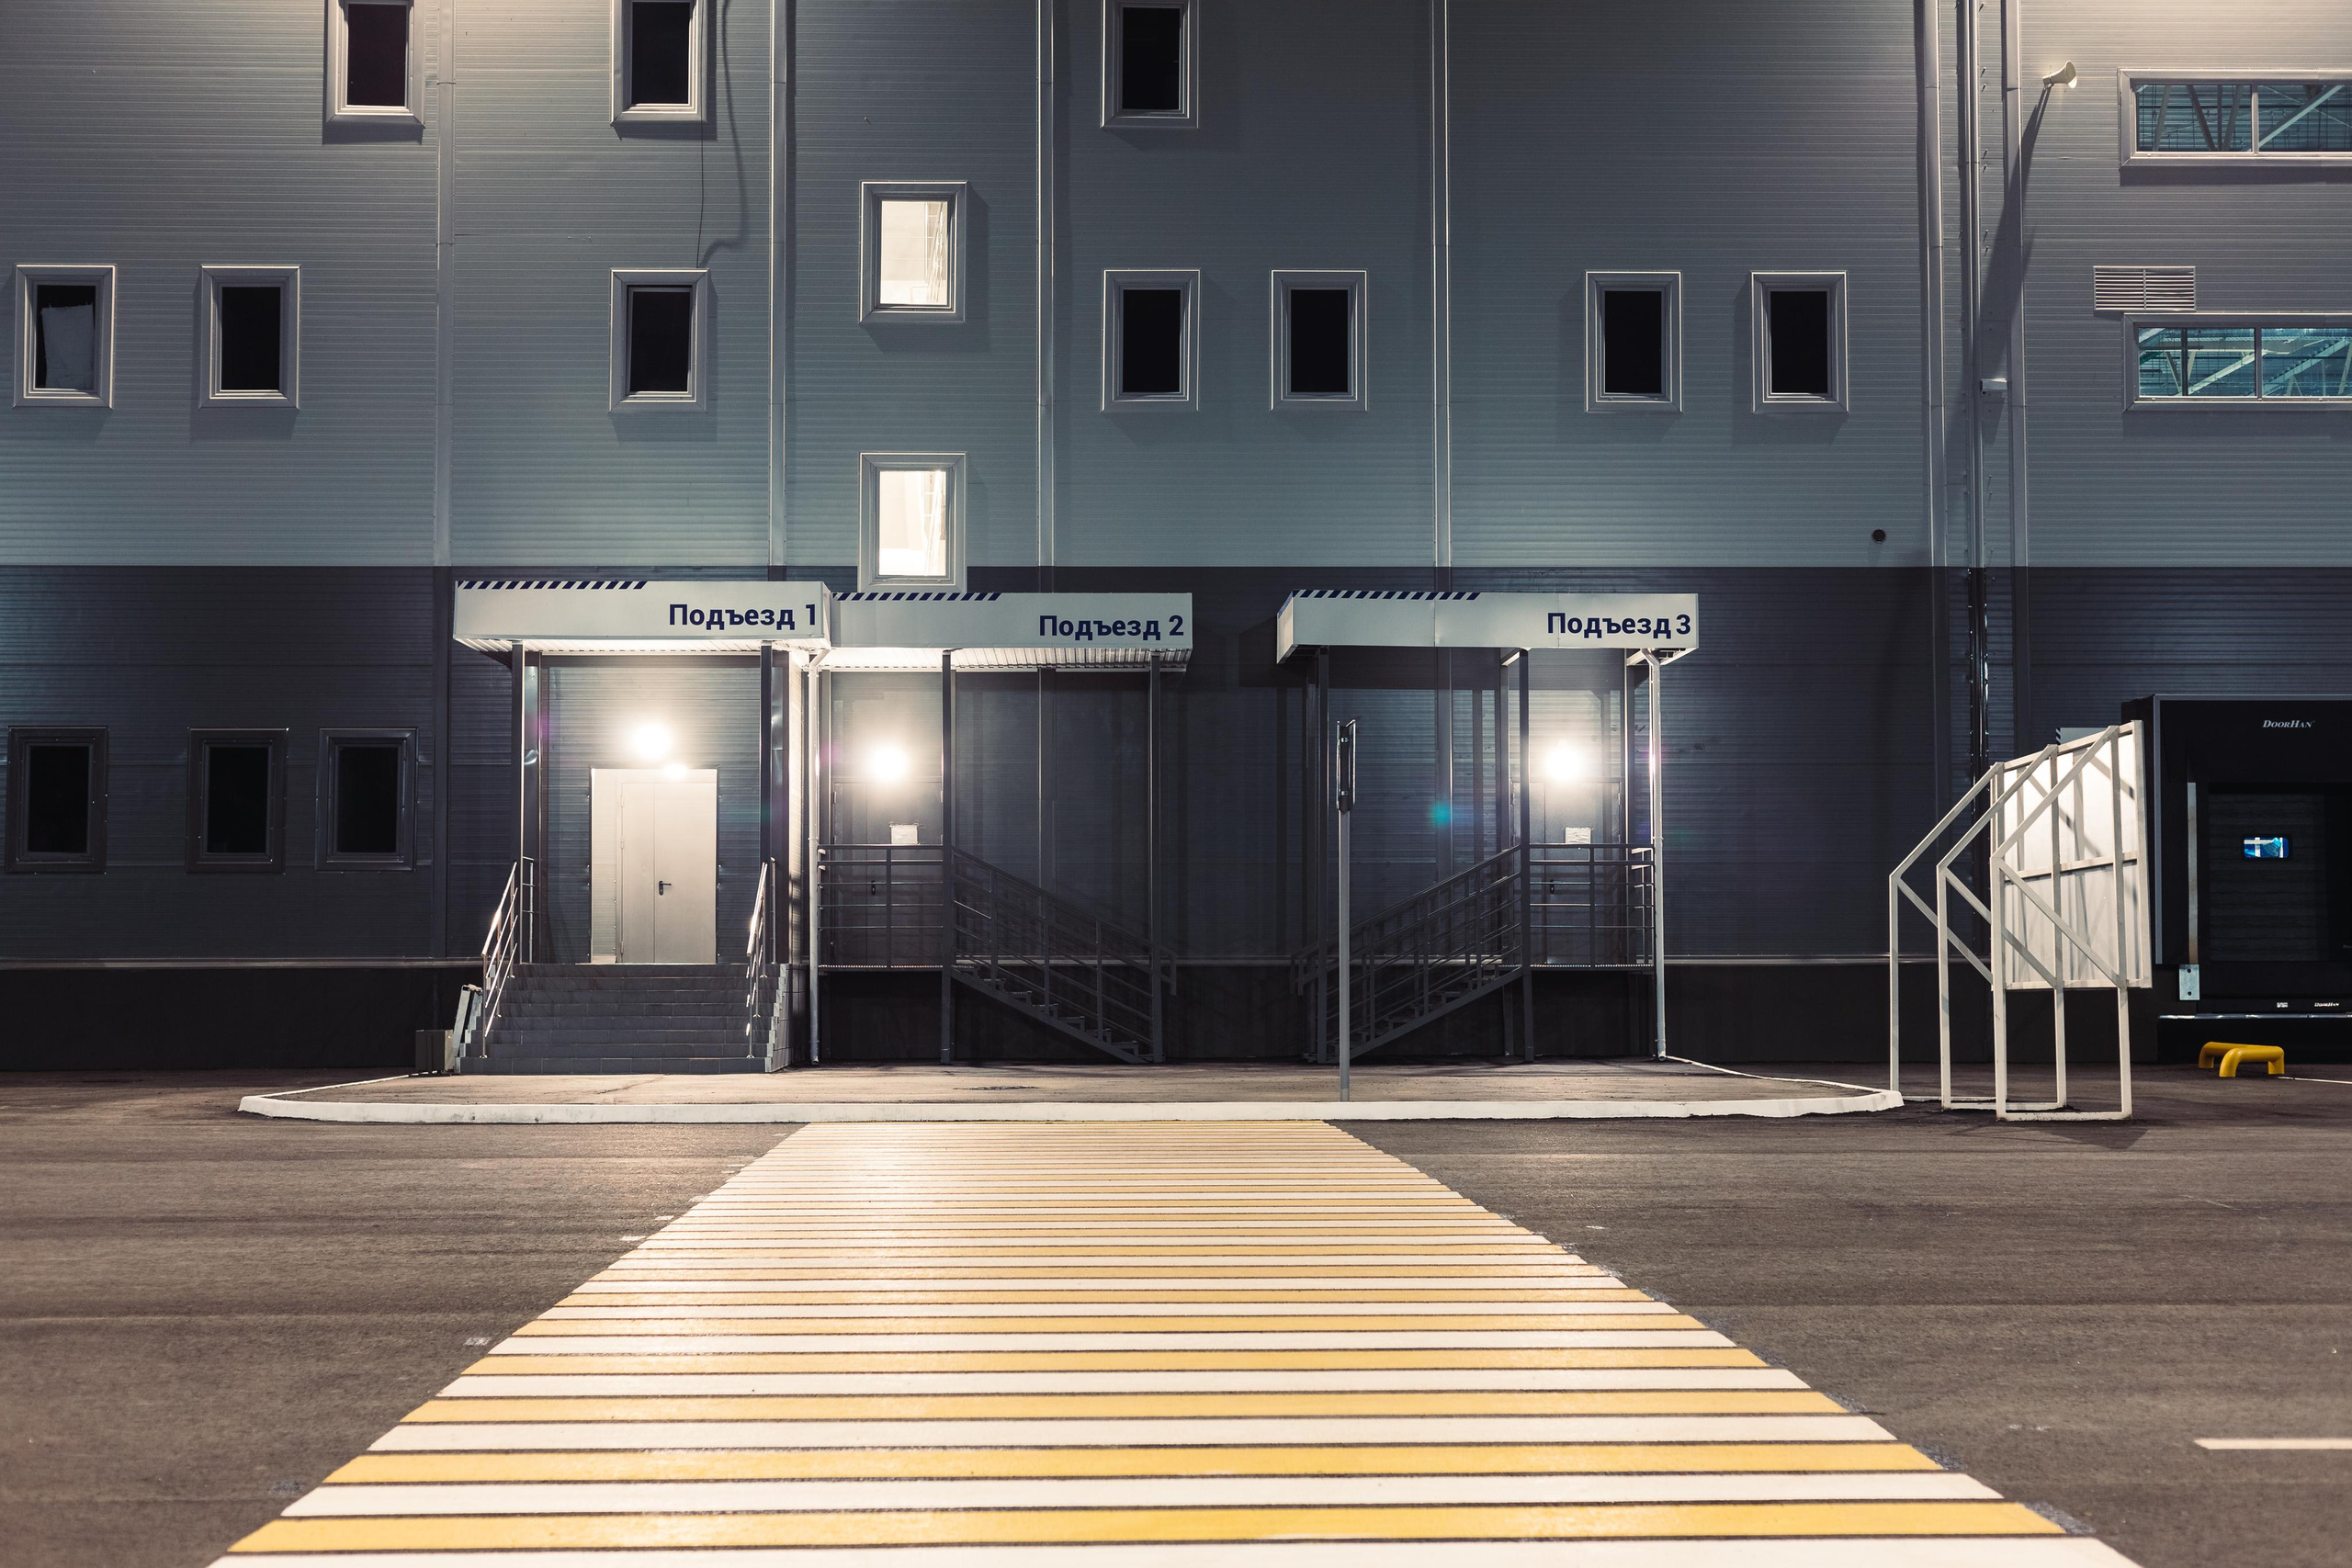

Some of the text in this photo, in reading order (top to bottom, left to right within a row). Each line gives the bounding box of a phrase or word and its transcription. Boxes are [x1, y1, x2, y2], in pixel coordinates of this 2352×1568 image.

[669, 604, 816, 631] Подъезд 1
[1039, 615, 1184, 641] Подъезд 2
[1547, 612, 1691, 639] Подъезд 3
